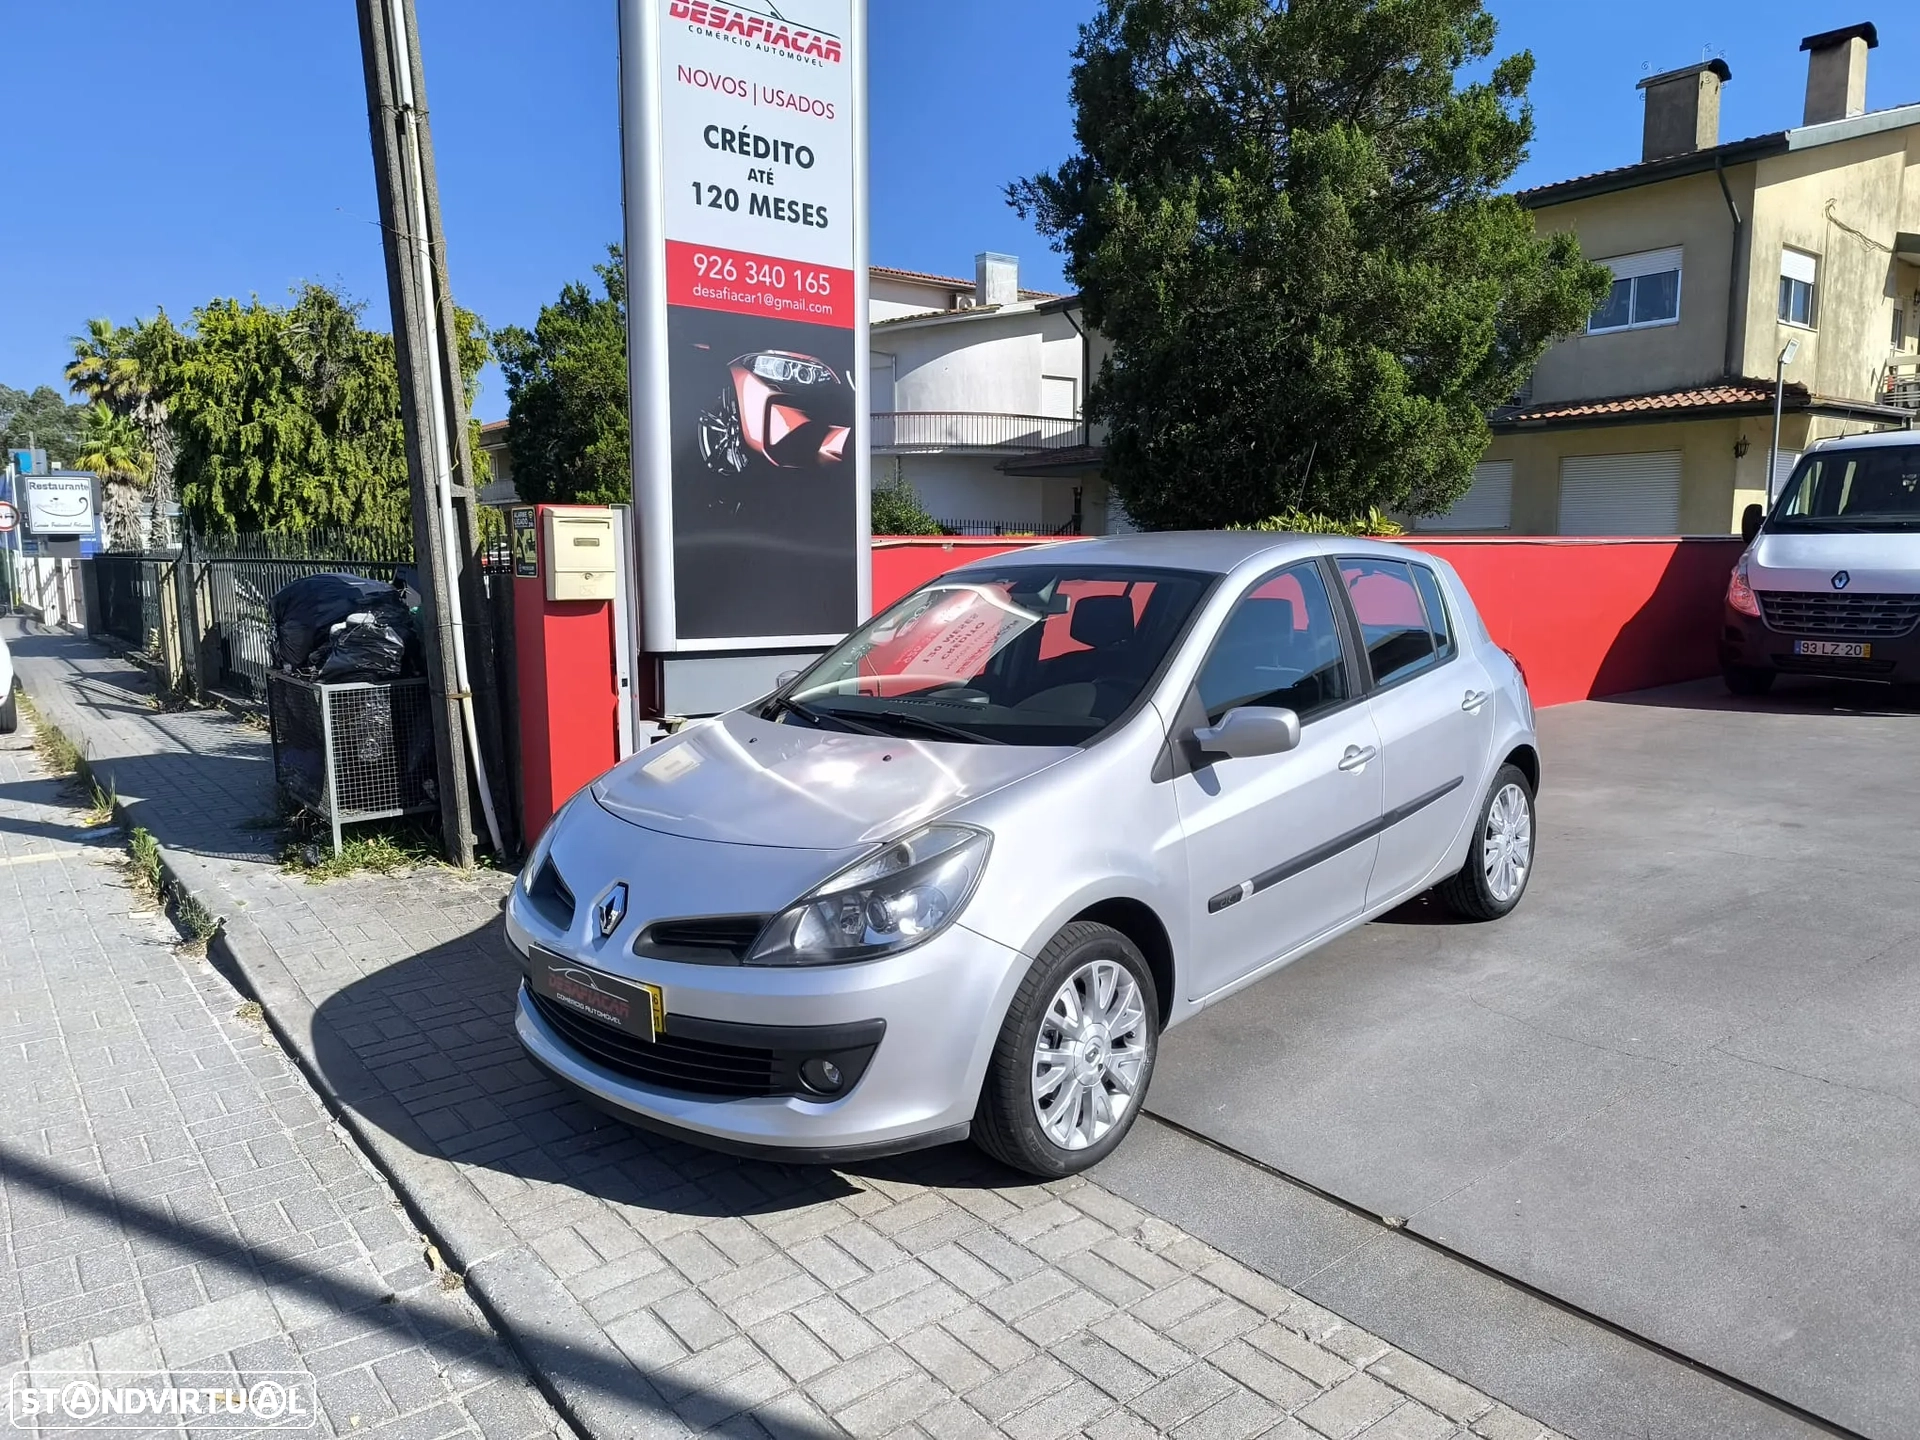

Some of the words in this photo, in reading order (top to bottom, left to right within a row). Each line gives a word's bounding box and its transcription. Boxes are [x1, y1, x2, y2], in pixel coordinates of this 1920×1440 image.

[669, 0, 842, 63] DESAFIACAR
[677, 64, 748, 98] NOVOS
[763, 86, 835, 119] USADOS
[703, 124, 815, 169] CRÉDITO
[747, 167, 775, 186] ATÉ
[692, 181, 739, 212] 120
[749, 192, 829, 229] MESES
[693, 253, 738, 282] 926
[745, 261, 786, 289] 340
[793, 270, 831, 296] 165
[692, 283, 833, 316] desafiacar1@gmail.com
[29, 482, 89, 492] Restaurante
[1802, 642, 1817, 654] 93
[1821, 643, 1840, 656] LZ
[1844, 644, 1863, 656] 20
